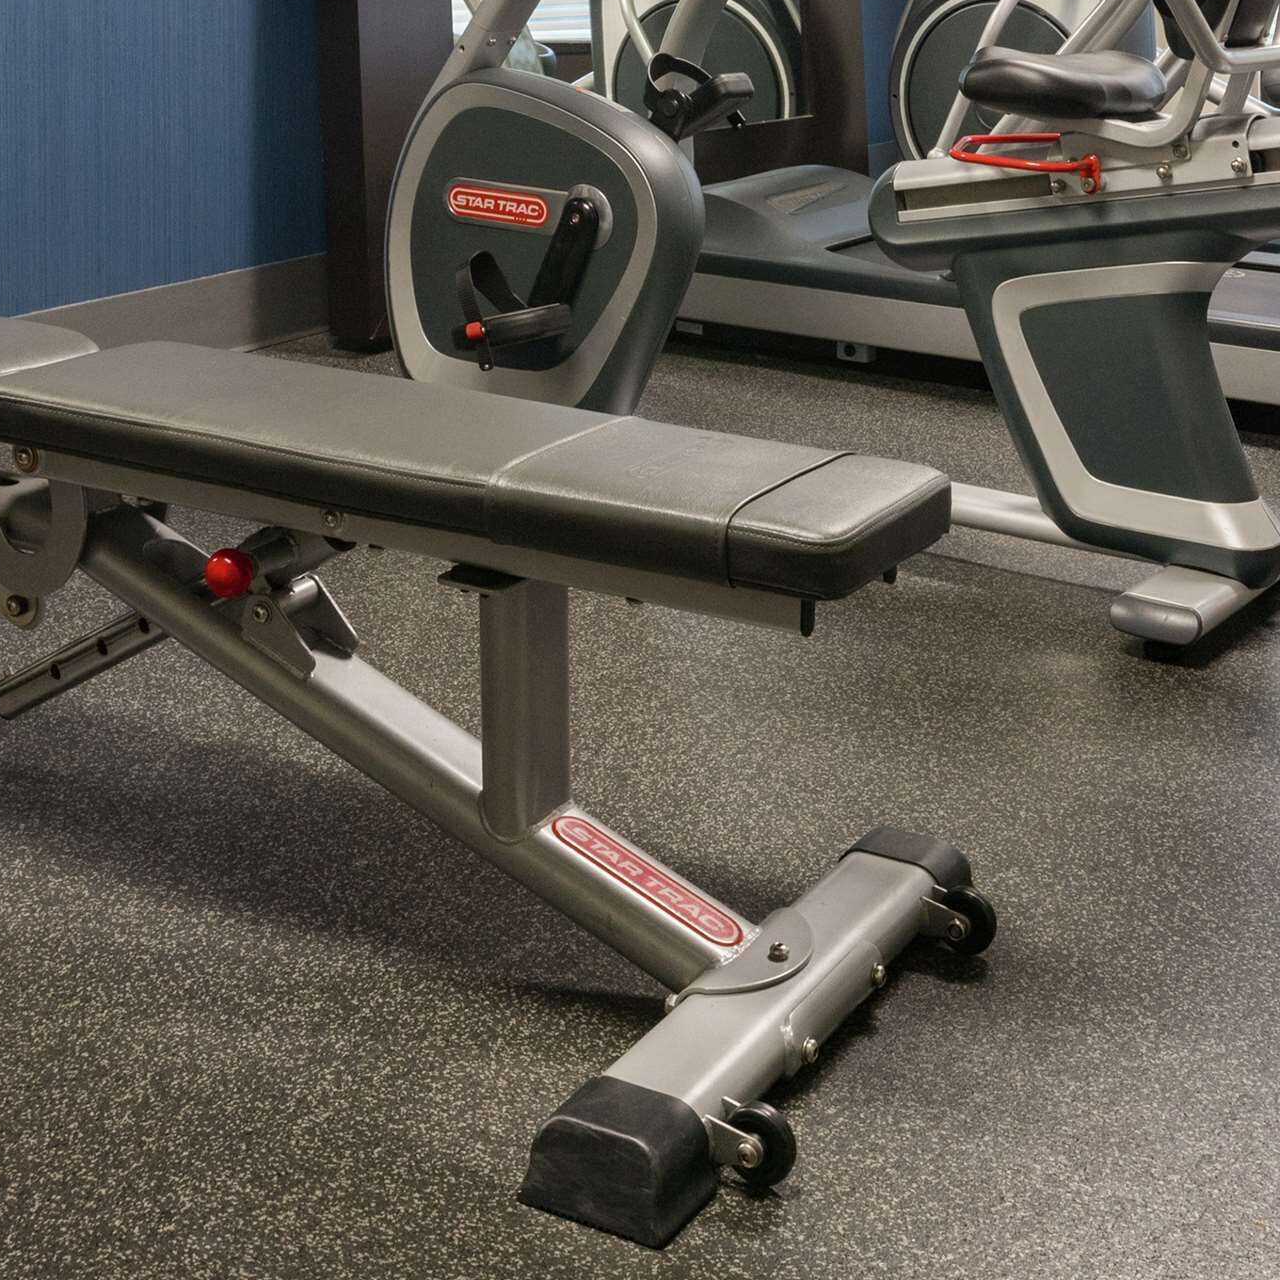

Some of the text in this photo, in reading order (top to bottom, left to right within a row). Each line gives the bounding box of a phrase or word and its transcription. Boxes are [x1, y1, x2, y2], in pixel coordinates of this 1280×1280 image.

[454, 194, 540, 216] STAR TRAC
[567, 826, 726, 933] STAR TRAC
